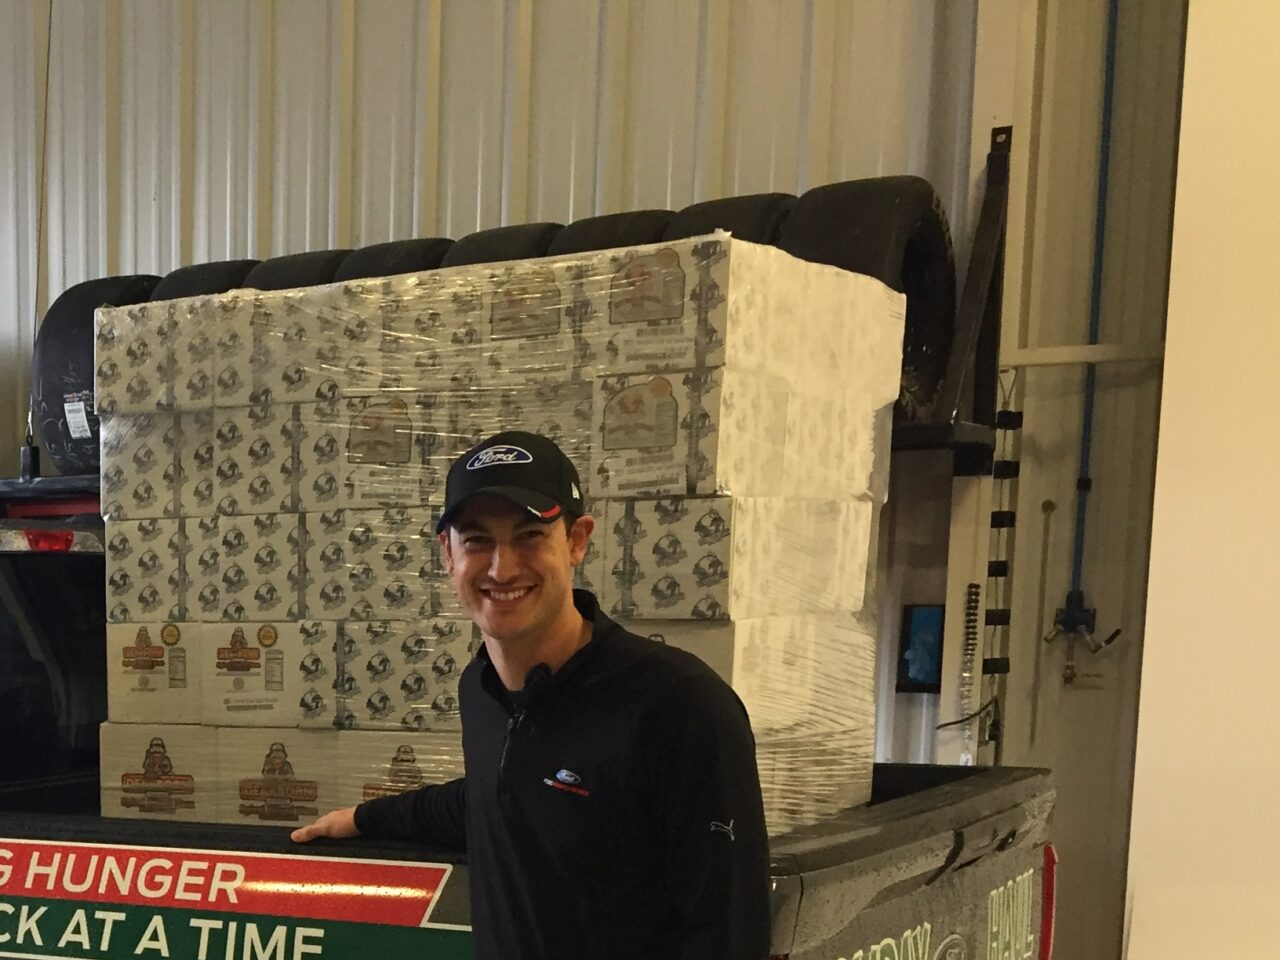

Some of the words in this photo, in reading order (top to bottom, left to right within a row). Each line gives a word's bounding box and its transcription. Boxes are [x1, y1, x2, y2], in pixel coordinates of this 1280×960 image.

[474, 449, 519, 467] Ford
[24, 851, 246, 904] HUNGER
[58, 909, 127, 951] AT
[134, 915, 170, 957] A
